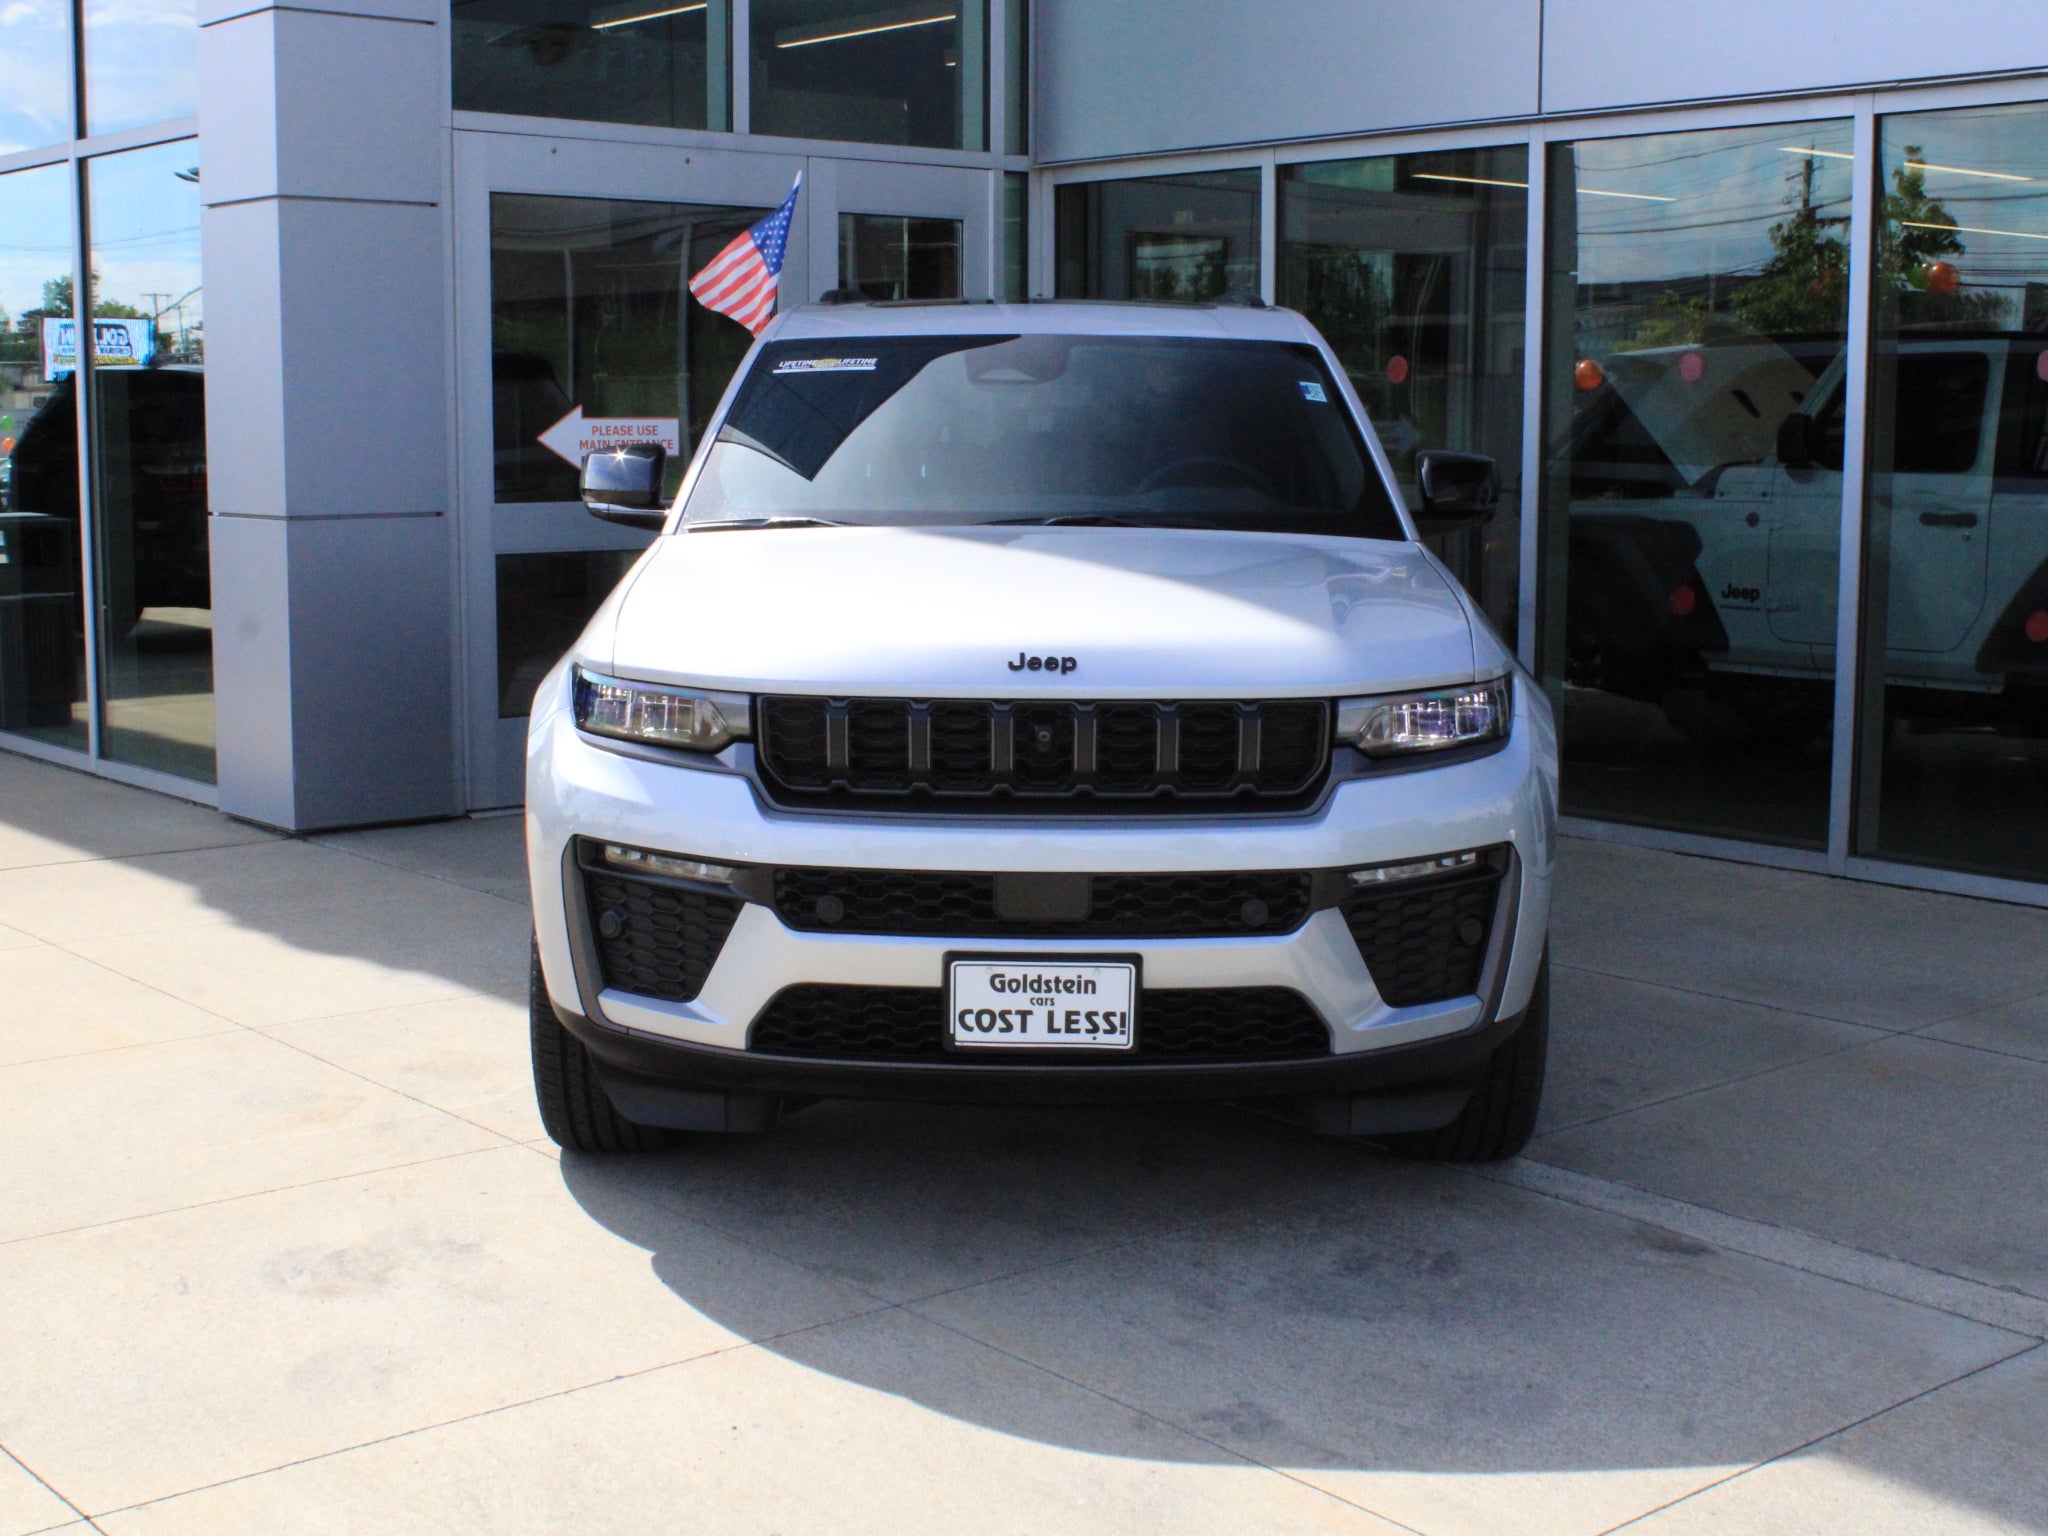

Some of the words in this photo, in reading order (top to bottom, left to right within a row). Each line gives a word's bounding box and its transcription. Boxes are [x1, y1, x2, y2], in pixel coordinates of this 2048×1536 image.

[779, 360, 818, 368] LIFETIME
[592, 425, 634, 436] PLEASE
[637, 425, 659, 436] USE
[579, 440, 611, 450] MAIN
[1721, 583, 1760, 603] Jeep
[1008, 652, 1077, 675] Jeep
[989, 973, 1097, 995] Goldstein
[1030, 996, 1055, 1007] cars
[958, 1008, 1034, 1034] COST
[1047, 1009, 1127, 1036] LESS!
